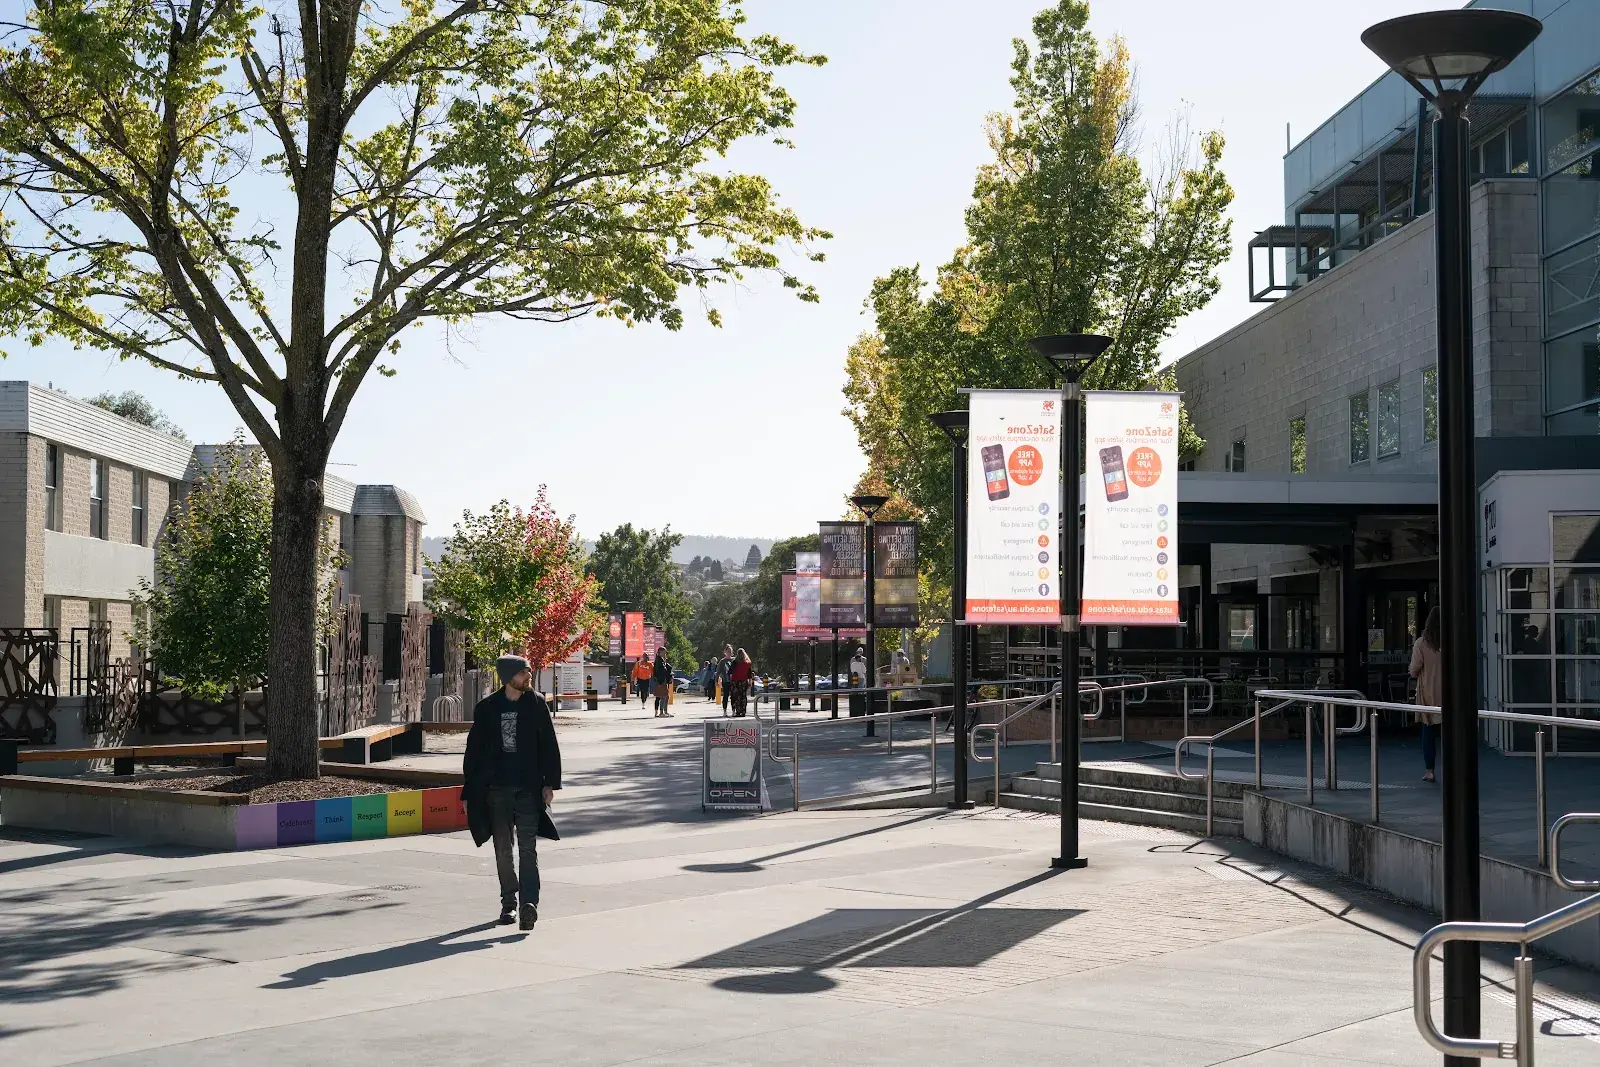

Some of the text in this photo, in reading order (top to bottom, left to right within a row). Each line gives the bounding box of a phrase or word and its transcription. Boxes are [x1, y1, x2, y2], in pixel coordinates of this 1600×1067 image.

[725, 728, 756, 736] UNI
[324, 816, 344, 824] Think
[357, 812, 383, 821] Respect
[394, 808, 416, 817] Accept
